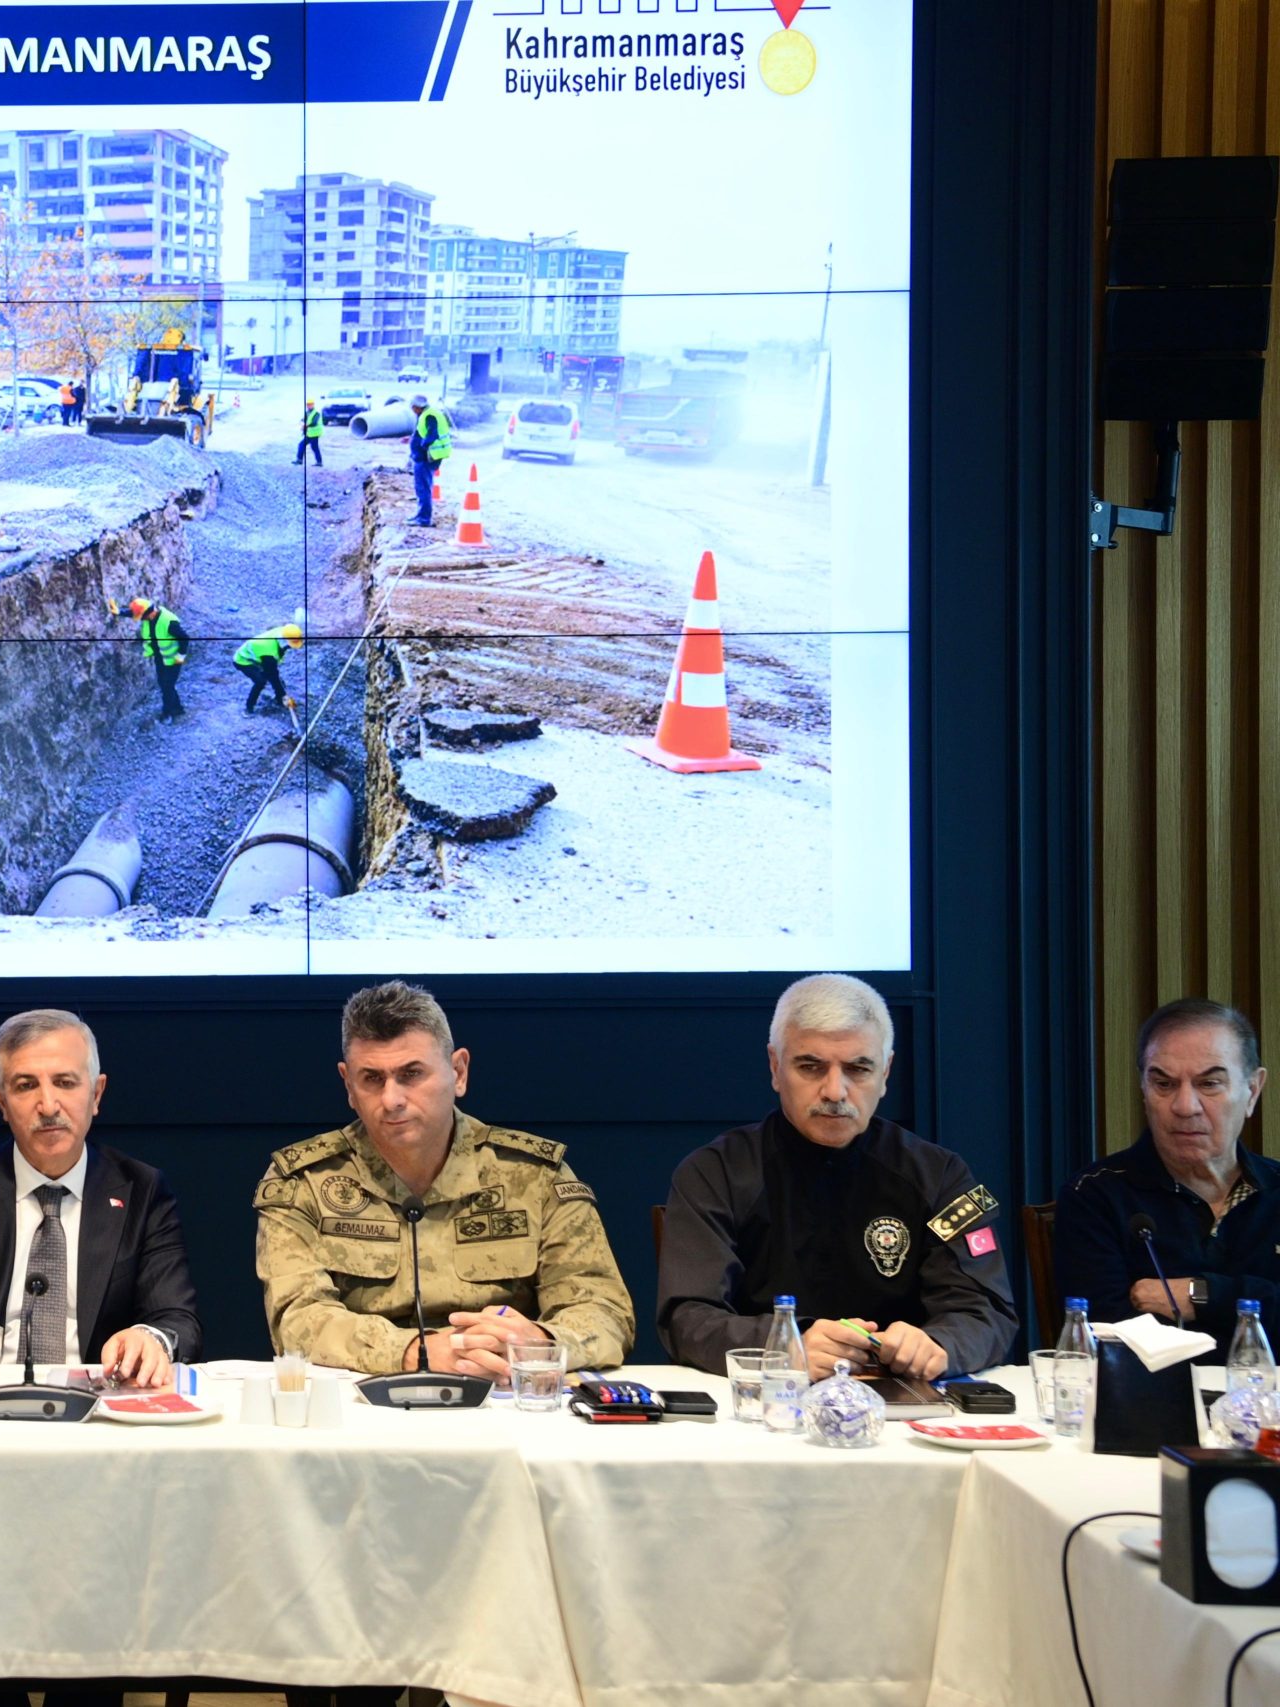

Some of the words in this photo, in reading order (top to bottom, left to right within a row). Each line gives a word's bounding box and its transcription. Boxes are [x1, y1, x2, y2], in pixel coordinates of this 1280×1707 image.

[507, 27, 744, 60] Kahramanmaraş
[506, 67, 626, 100] Büyükşehir
[635, 65, 745, 97] Belediyesi
